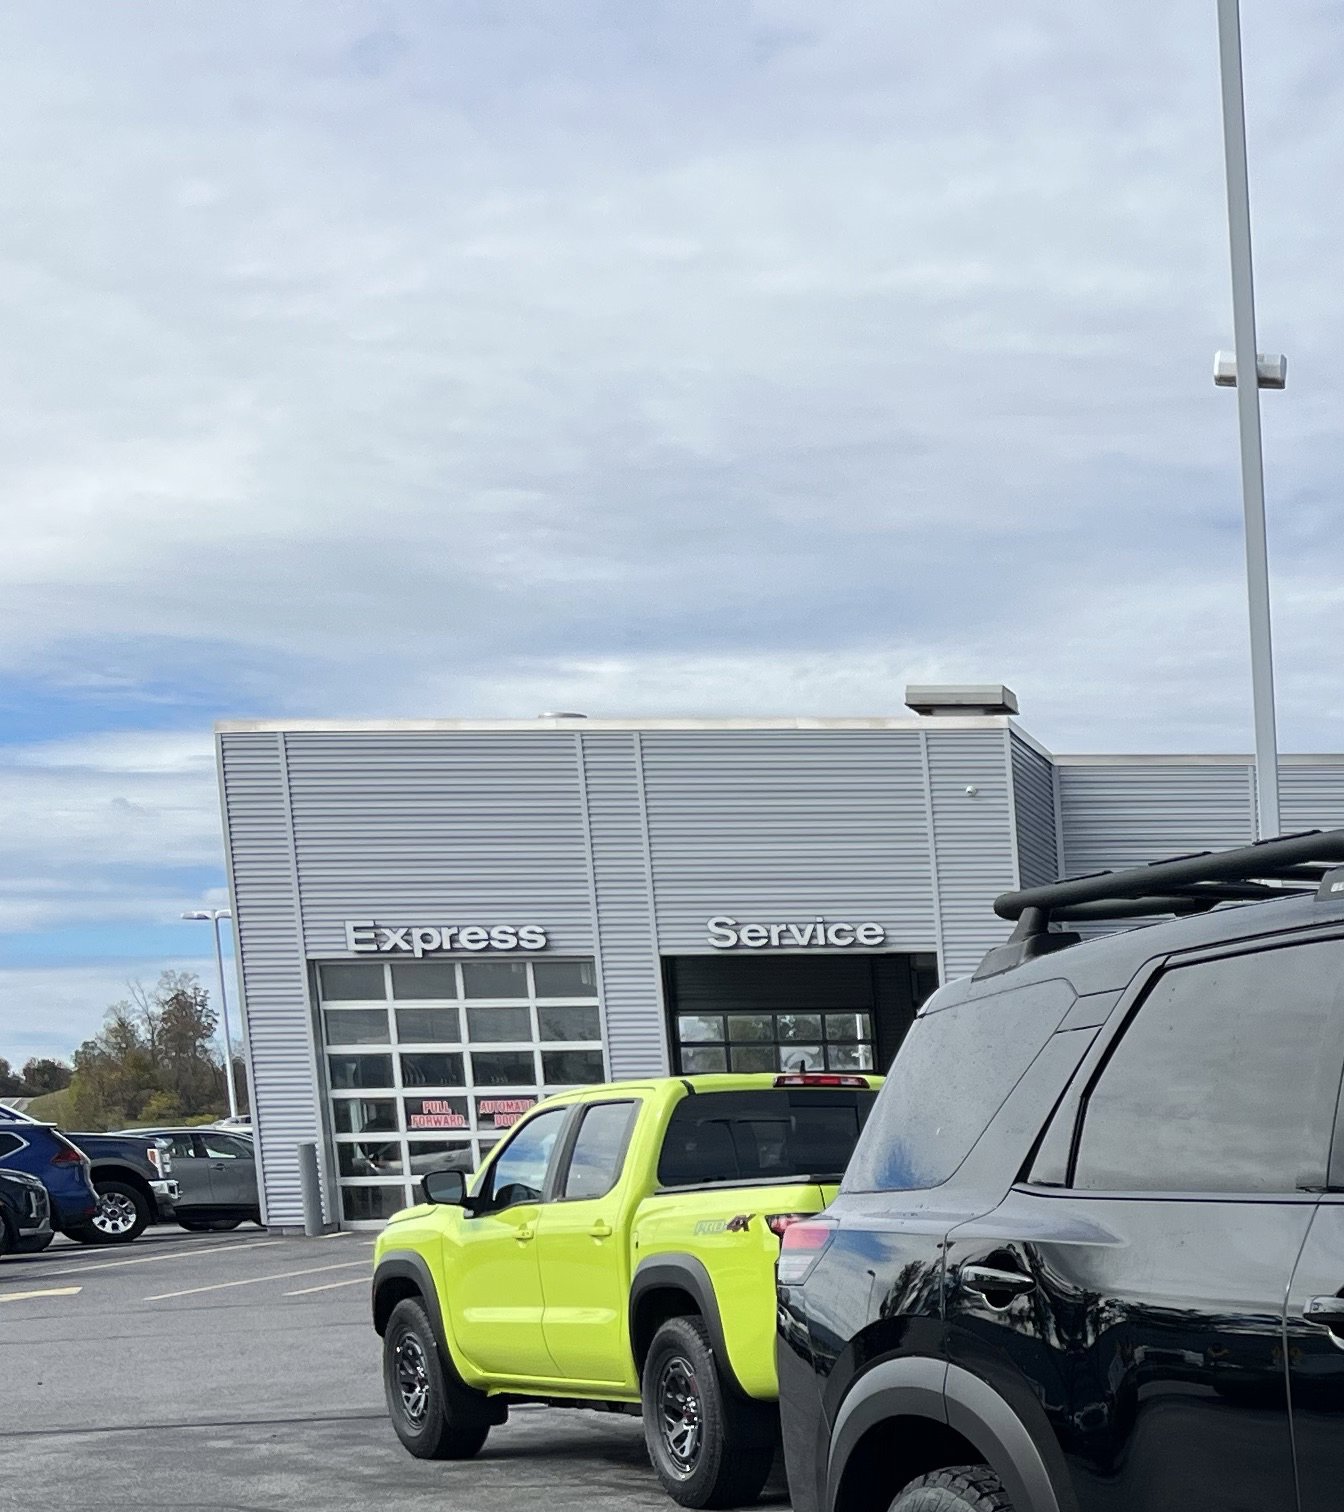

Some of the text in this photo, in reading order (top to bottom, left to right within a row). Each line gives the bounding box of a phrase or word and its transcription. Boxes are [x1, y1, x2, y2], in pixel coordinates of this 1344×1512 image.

[345, 920, 549, 958] Express
[706, 916, 886, 948] Service
[422, 1100, 452, 1114] PULL
[411, 1114, 465, 1128] FORWARD
